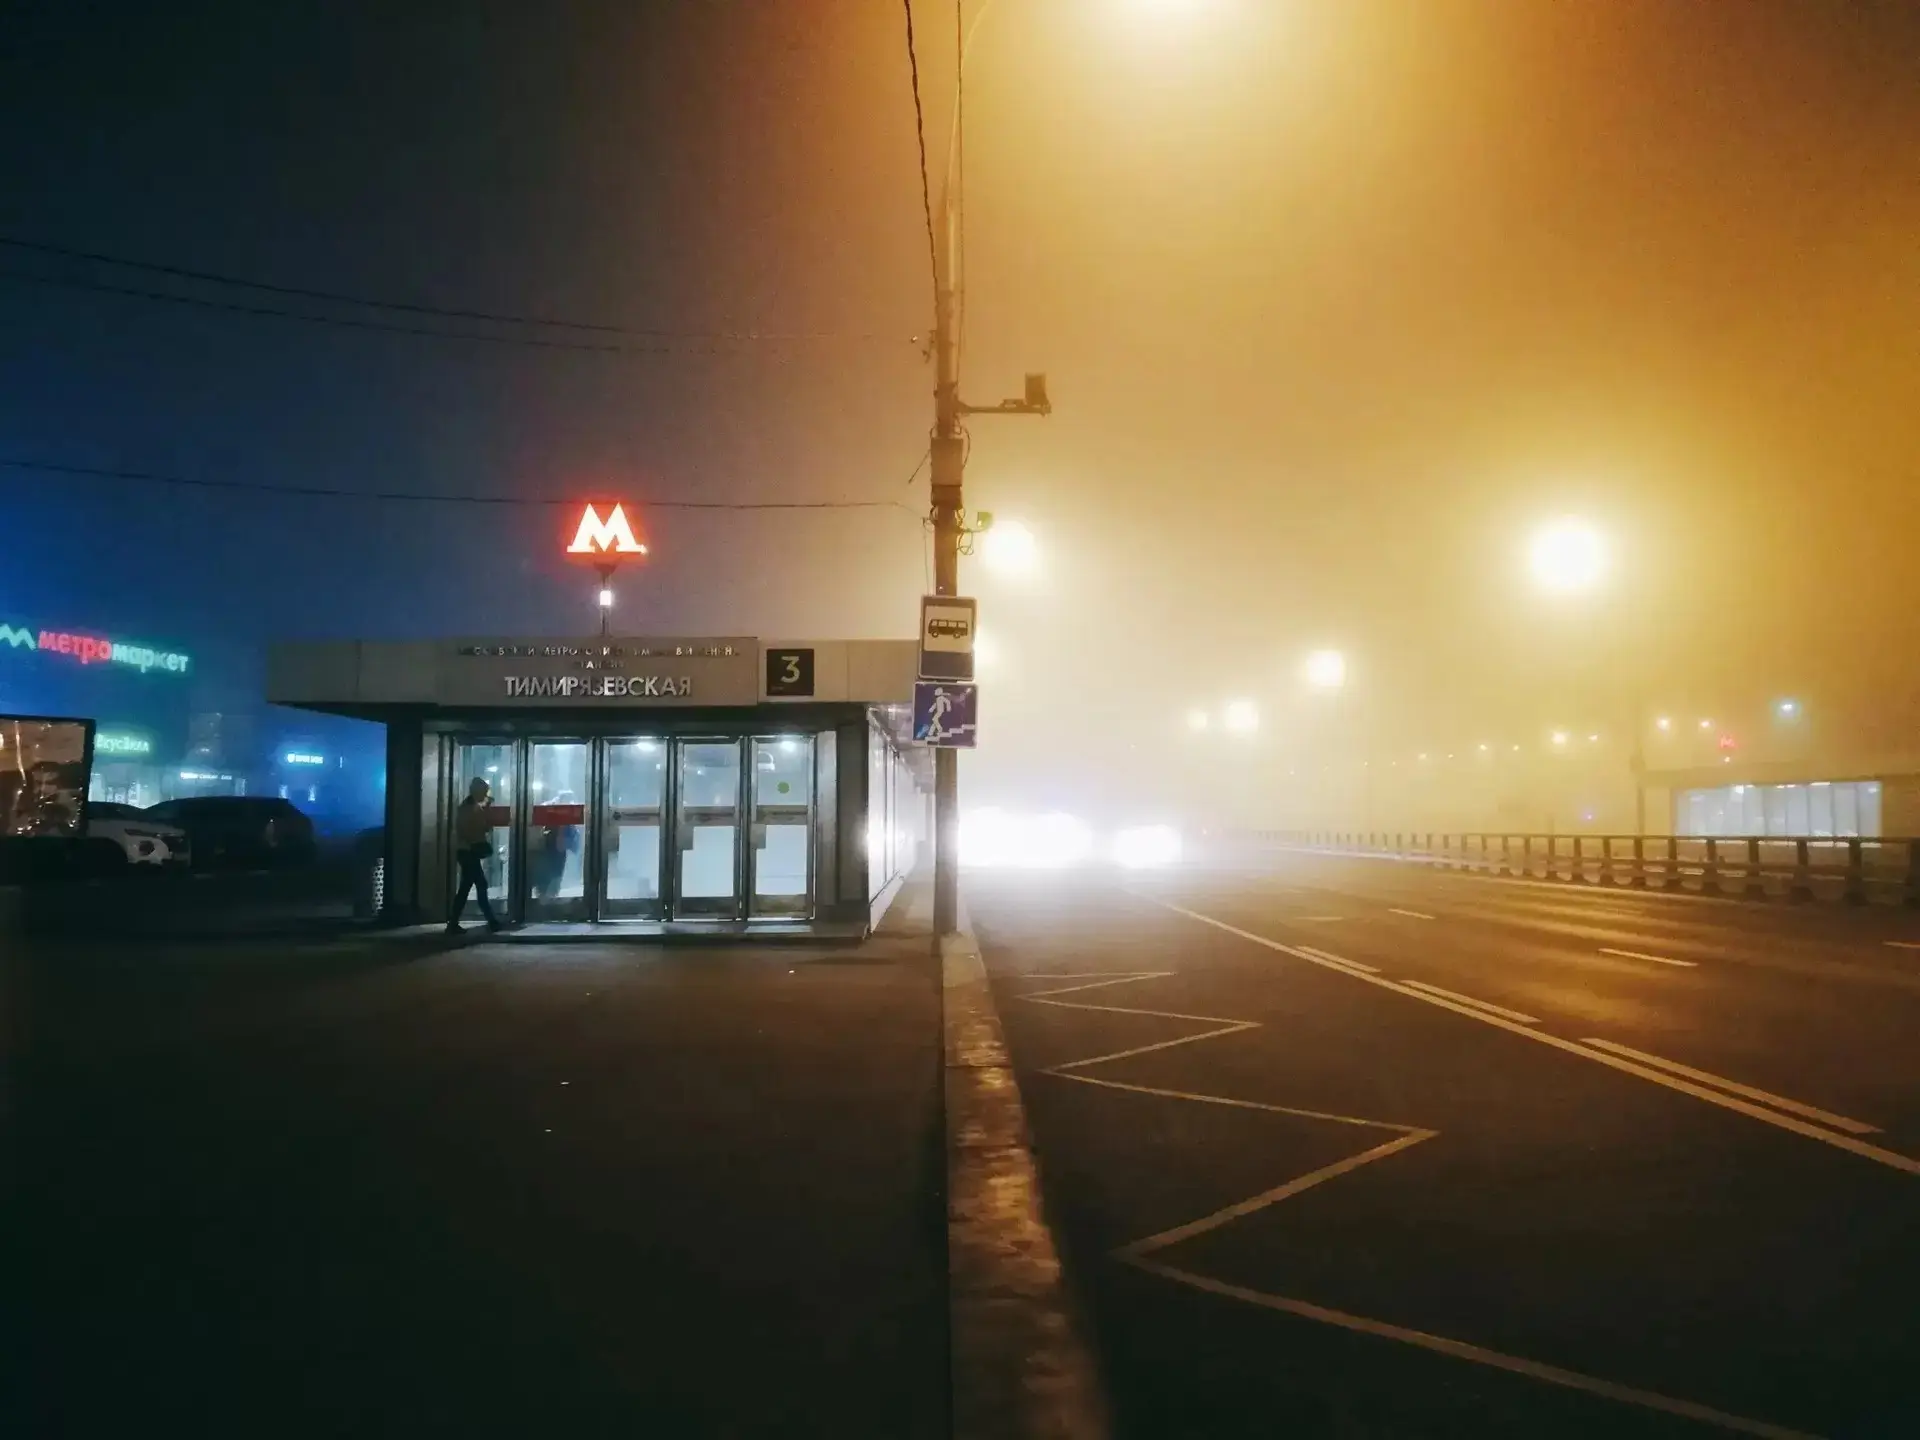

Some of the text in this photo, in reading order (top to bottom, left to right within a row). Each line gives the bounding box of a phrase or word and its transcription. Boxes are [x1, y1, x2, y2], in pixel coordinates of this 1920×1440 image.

[567, 502, 647, 553] М
[780, 655, 800, 684] 3
[504, 675, 691, 697] ТИМИРЯЗЕВСКАЯ
